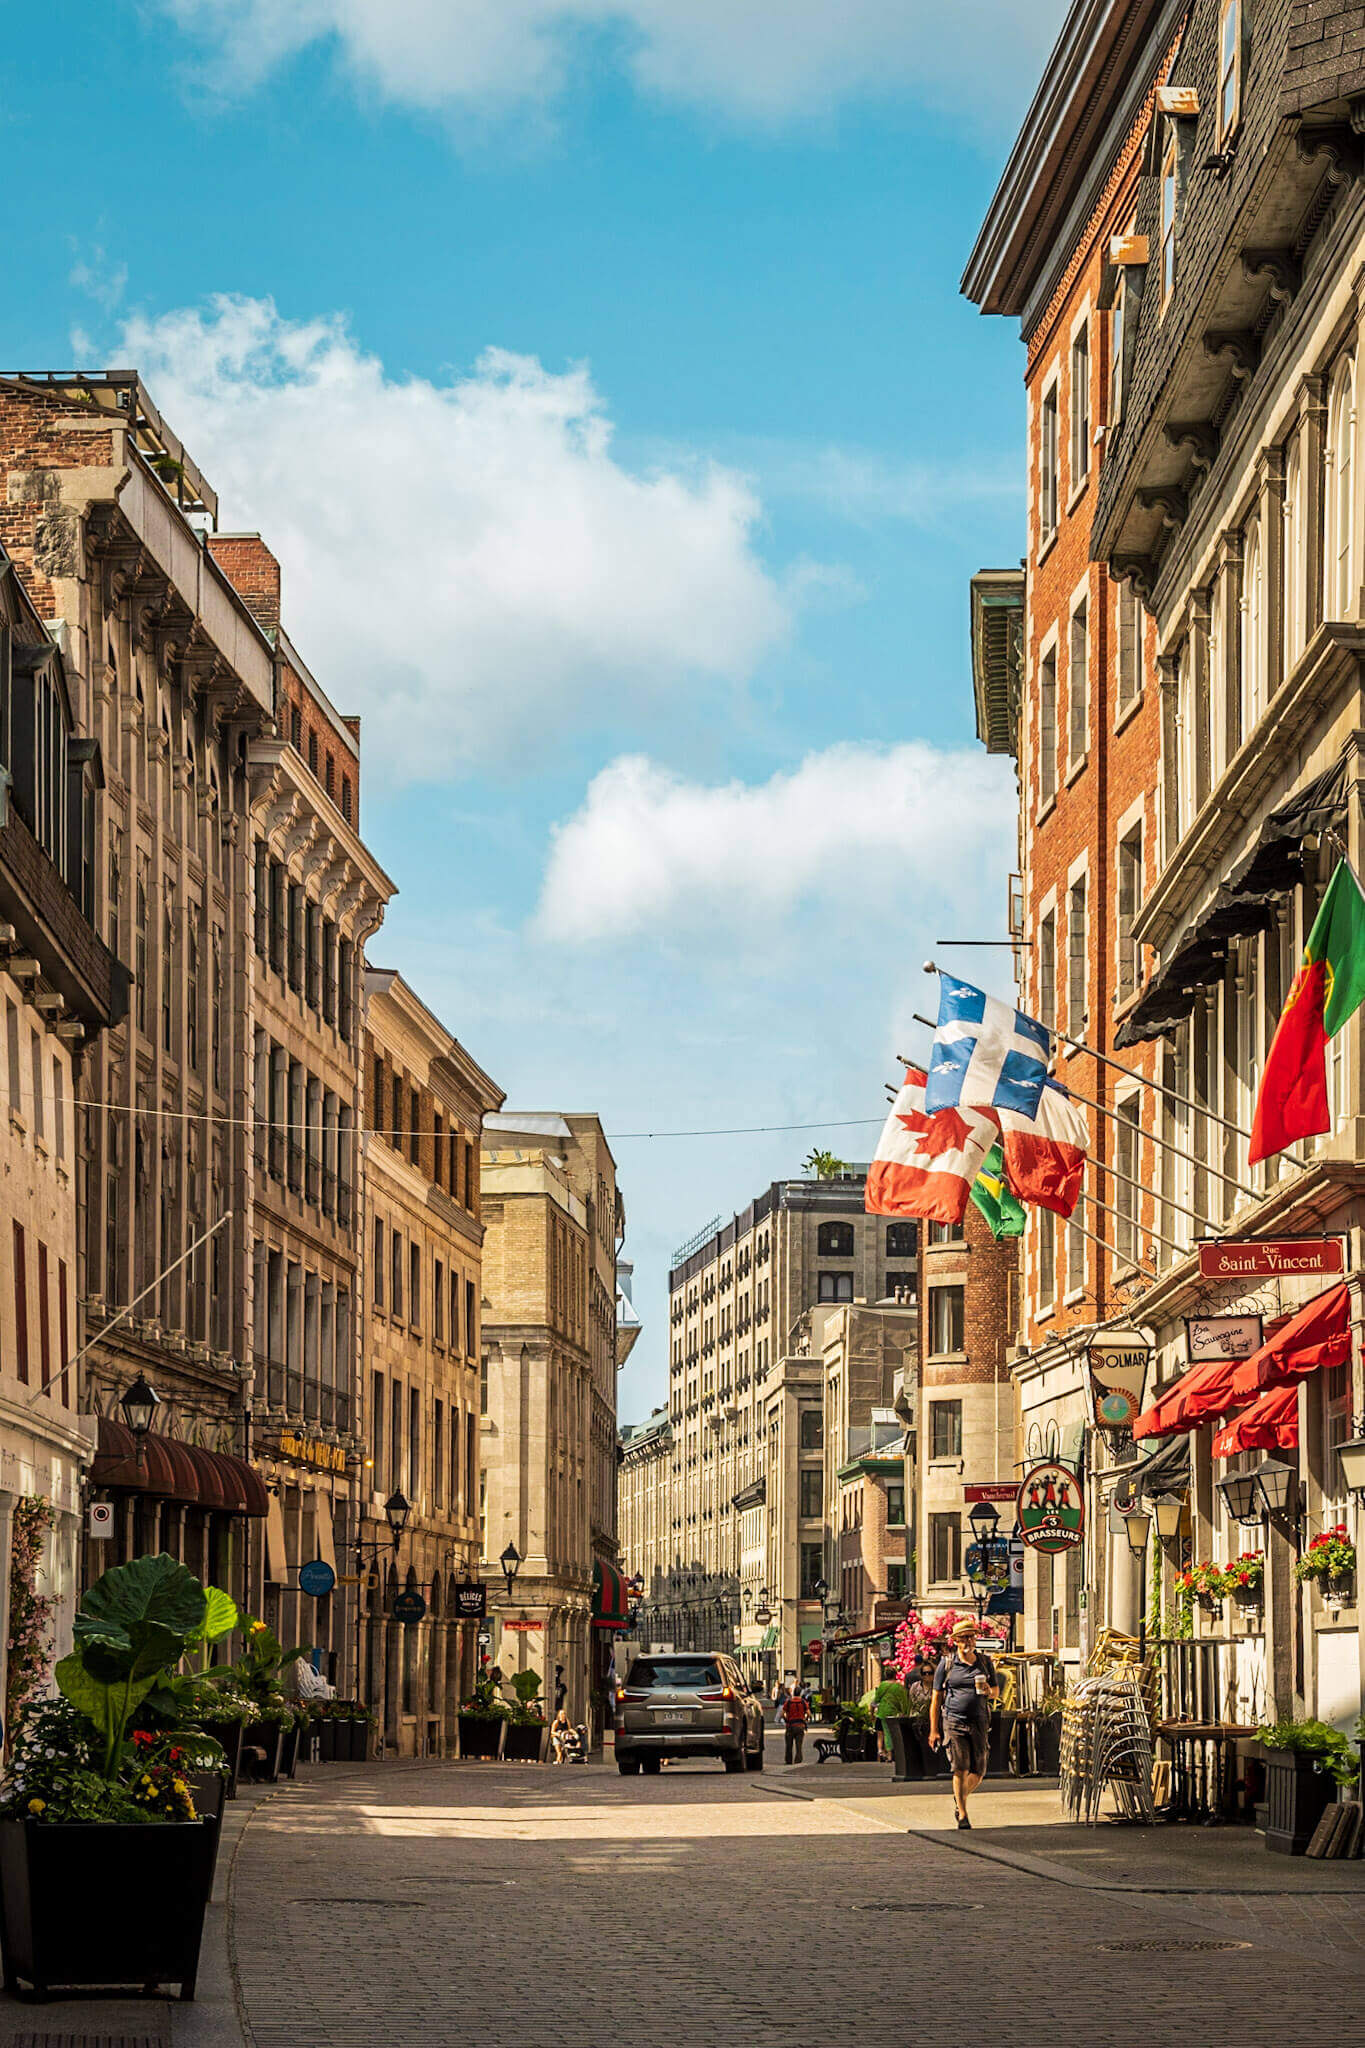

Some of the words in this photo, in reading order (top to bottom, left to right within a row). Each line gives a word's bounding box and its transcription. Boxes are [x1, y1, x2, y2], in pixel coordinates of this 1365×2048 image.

[1262, 1246, 1279, 1254] Rue
[1219, 1254, 1323, 1271] Saint-Vincent
[1193, 1328, 1243, 1350] Sauvagine
[1090, 1349, 1145, 1369] SOLMAR
[1050, 1517, 1057, 1526] 3
[1027, 1529, 1080, 1542] BRASSEURS
